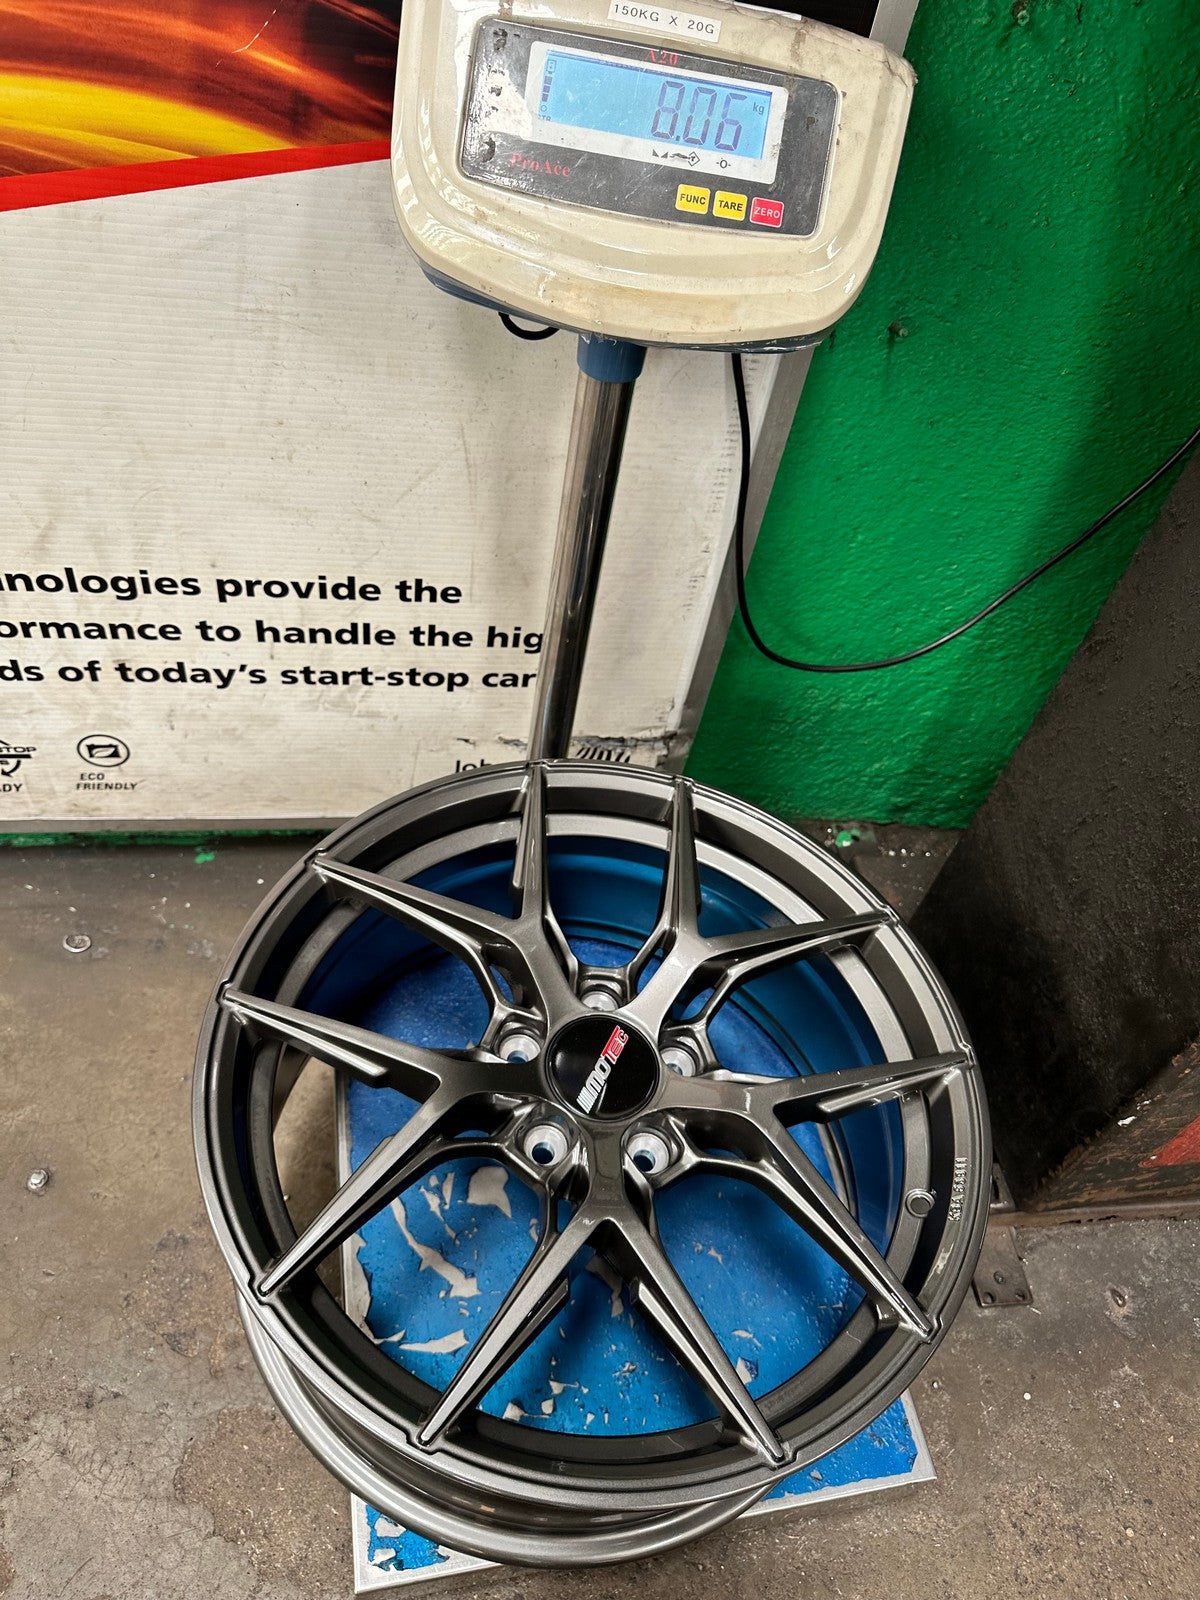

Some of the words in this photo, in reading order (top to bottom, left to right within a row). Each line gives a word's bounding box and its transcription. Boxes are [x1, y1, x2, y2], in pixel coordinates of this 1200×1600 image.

[614, 4, 660, 22] 150KG
[668, 15, 679, 27] X
[687, 19, 715, 34] 20G
[651, 80, 748, 152] 8.06
[752, 102, 766, 115] kg
[509, 152, 572, 177] ProAce
[679, 193, 707, 206] FUNC
[718, 199, 744, 212] TARE
[753, 206, 781, 219] ZERO
[0, 567, 202, 601] nologies
[216, 575, 382, 603] provide
[395, 578, 463, 604] the
[195, 620, 242, 643] to
[255, 620, 397, 646] handle
[409, 624, 474, 647] the
[58, 660, 103, 682] of
[115, 661, 268, 690] today's
[280, 665, 470, 692] start-stop
[76, 782, 138, 791] FRIENDLY
[80, 772, 105, 781] ECO
